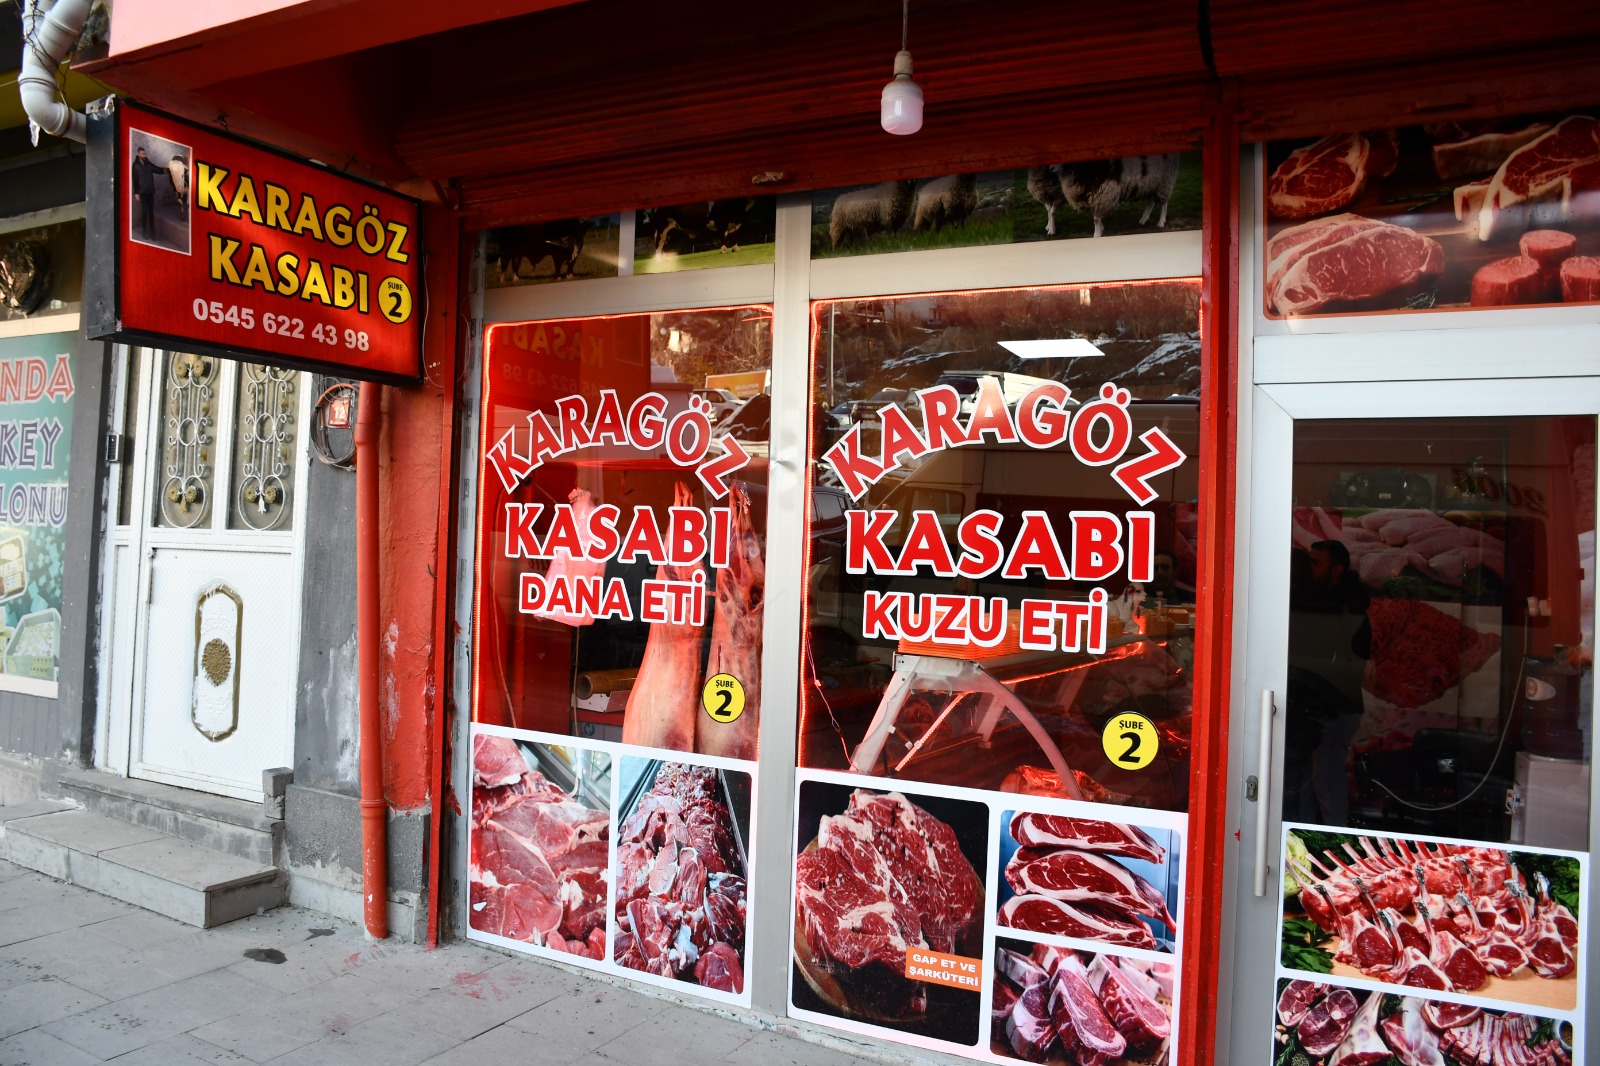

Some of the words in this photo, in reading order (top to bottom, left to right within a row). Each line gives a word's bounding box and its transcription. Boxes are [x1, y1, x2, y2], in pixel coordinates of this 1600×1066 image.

[195, 161, 409, 264] KARAGÖZ
[209, 234, 369, 313] KASABI
[387, 281, 403, 292] ŞUBE
[193, 298, 254, 329] 0545
[263, 312, 305, 339] 622
[312, 322, 338, 345] 43
[345, 329, 369, 351] 98
[388, 292, 403, 317] 2
[0, 353, 75, 403] NDA
[0, 417, 63, 470] KEY
[486, 389, 751, 500] KARAGÖZ
[821, 377, 1187, 507] KARAGÖZ
[505, 503, 732, 568] KASABI
[845, 510, 1155, 582] KASABI
[519, 572, 633, 620] DANA
[640, 568, 707, 627] ETİ
[862, 589, 1008, 648] KUZU
[1019, 587, 1108, 654] ETİ
[714, 689, 732, 717] 2
[715, 679, 735, 689] ŞUBE
[1118, 731, 1142, 764] 2
[1119, 719, 1144, 730] ŞUBE
[909, 965, 979, 987] ŞARKÜTERİ
[912, 953, 938, 965] GAP
[940, 959, 957, 969] ET
[960, 962, 977, 973] VE
